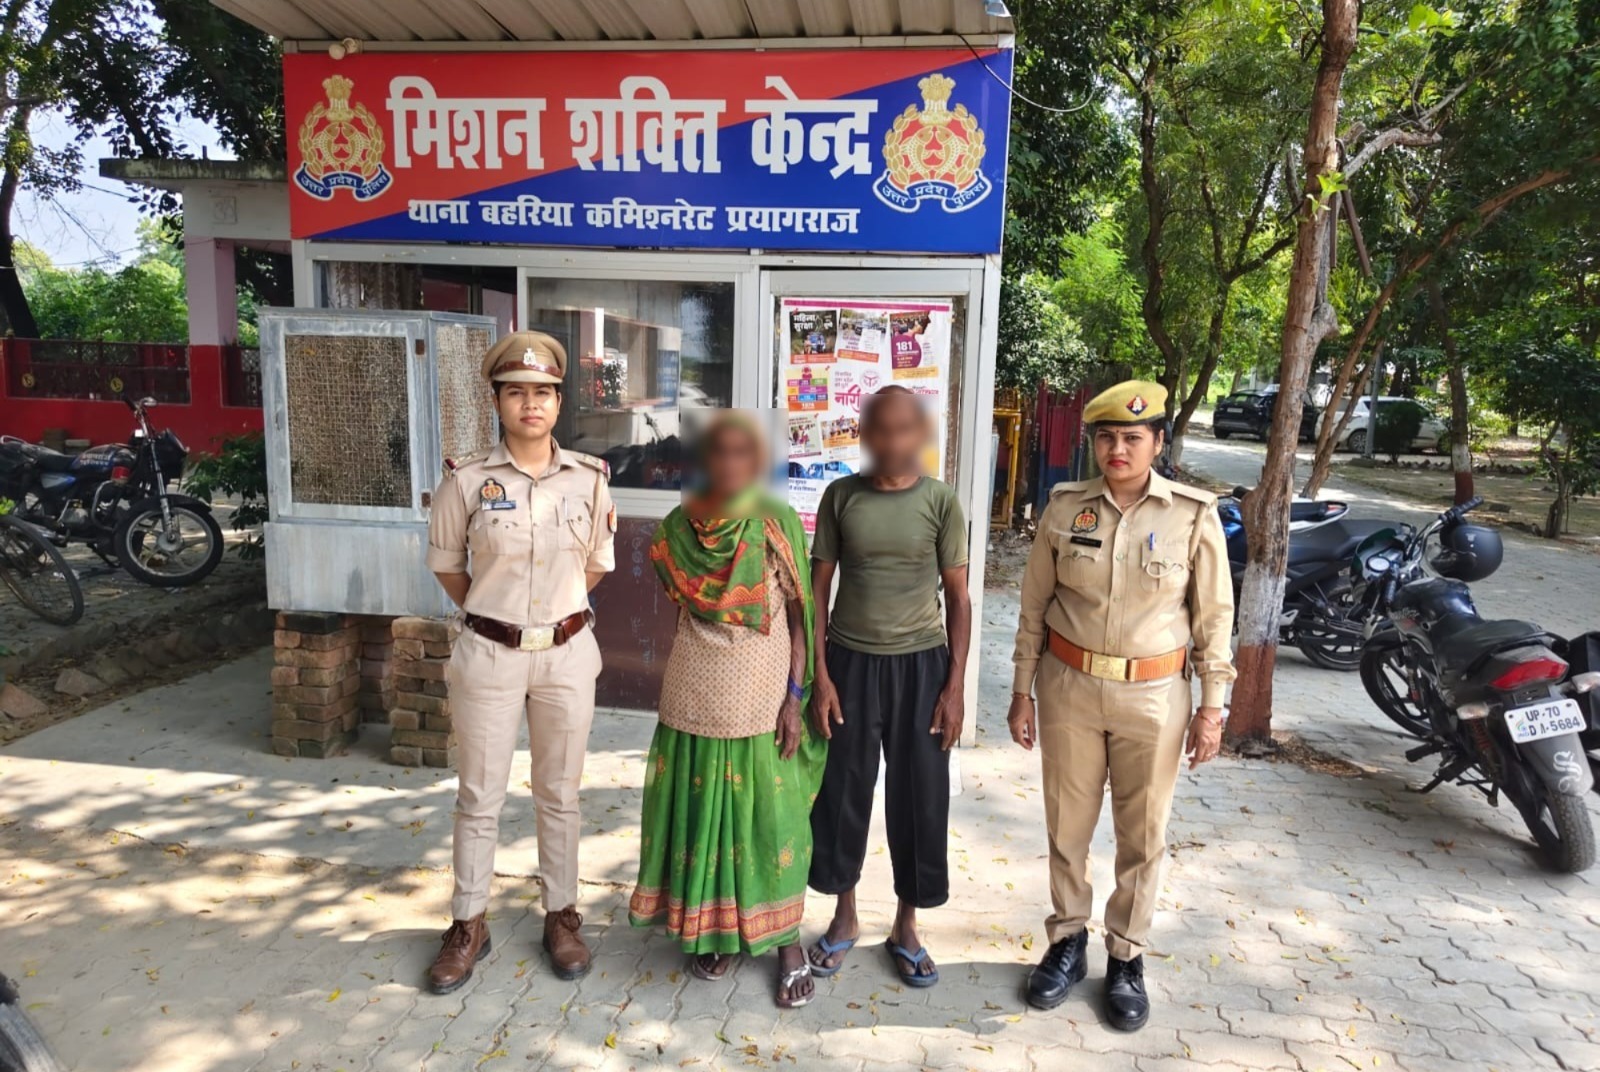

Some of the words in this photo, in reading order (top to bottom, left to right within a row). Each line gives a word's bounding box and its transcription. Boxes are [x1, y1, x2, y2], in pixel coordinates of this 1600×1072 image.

[386, 76, 547, 170] मिशन
[565, 76, 727, 173] शक्ति
[744, 76, 879, 180] केन्द्र
[882, 184, 910, 207] उत्तर
[913, 181, 950, 197] प्रदेश
[952, 182, 986, 209] पुलिस
[408, 200, 471, 224] थाना
[478, 195, 575, 228] बहरिया
[583, 197, 717, 231] कमिश्नरेट
[725, 206, 861, 234] प्रयागराज
[895, 341, 913, 351] 181
